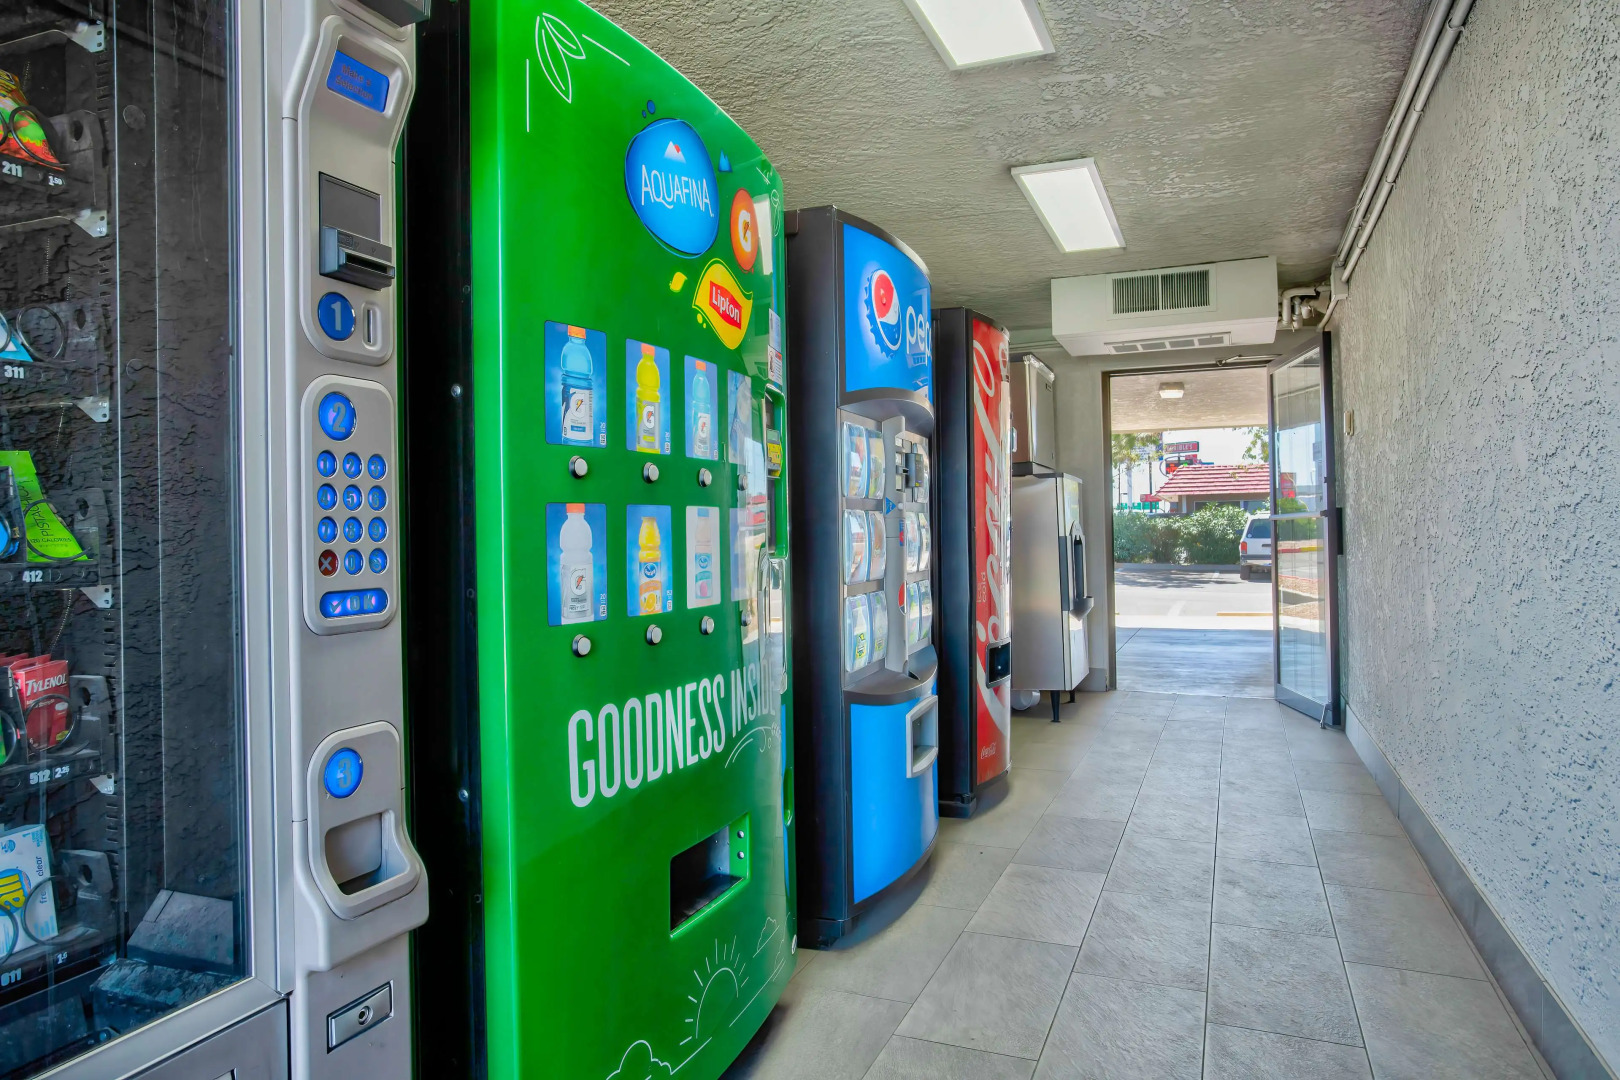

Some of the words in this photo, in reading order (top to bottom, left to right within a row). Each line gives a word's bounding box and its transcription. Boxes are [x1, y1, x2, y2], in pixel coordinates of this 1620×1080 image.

[2, 161, 23, 178] 211
[641, 164, 713, 217] AQUAFINA
[712, 286, 740, 324] Lipton
[330, 301, 342, 331] 1
[906, 305, 932, 367] pep
[4, 364, 25, 379] 311
[332, 401, 346, 433] 2
[321, 456, 328, 474] 1
[347, 458, 355, 475] 2
[371, 459, 379, 477] 3
[320, 488, 328, 506] 4
[346, 490, 355, 508] 5
[371, 491, 380, 508] 6
[321, 521, 329, 539] 7
[347, 522, 355, 539] 8
[371, 522, 380, 539] 9
[347, 554, 356, 571] 0
[22, 570, 43, 583] 412
[350, 594, 374, 611] OK
[25, 673, 68, 697] TYLENOL
[567, 673, 726, 808] GOODNESS
[29, 769, 51, 785] 512
[338, 757, 352, 788] 3
[35, 856, 43, 877] clear
